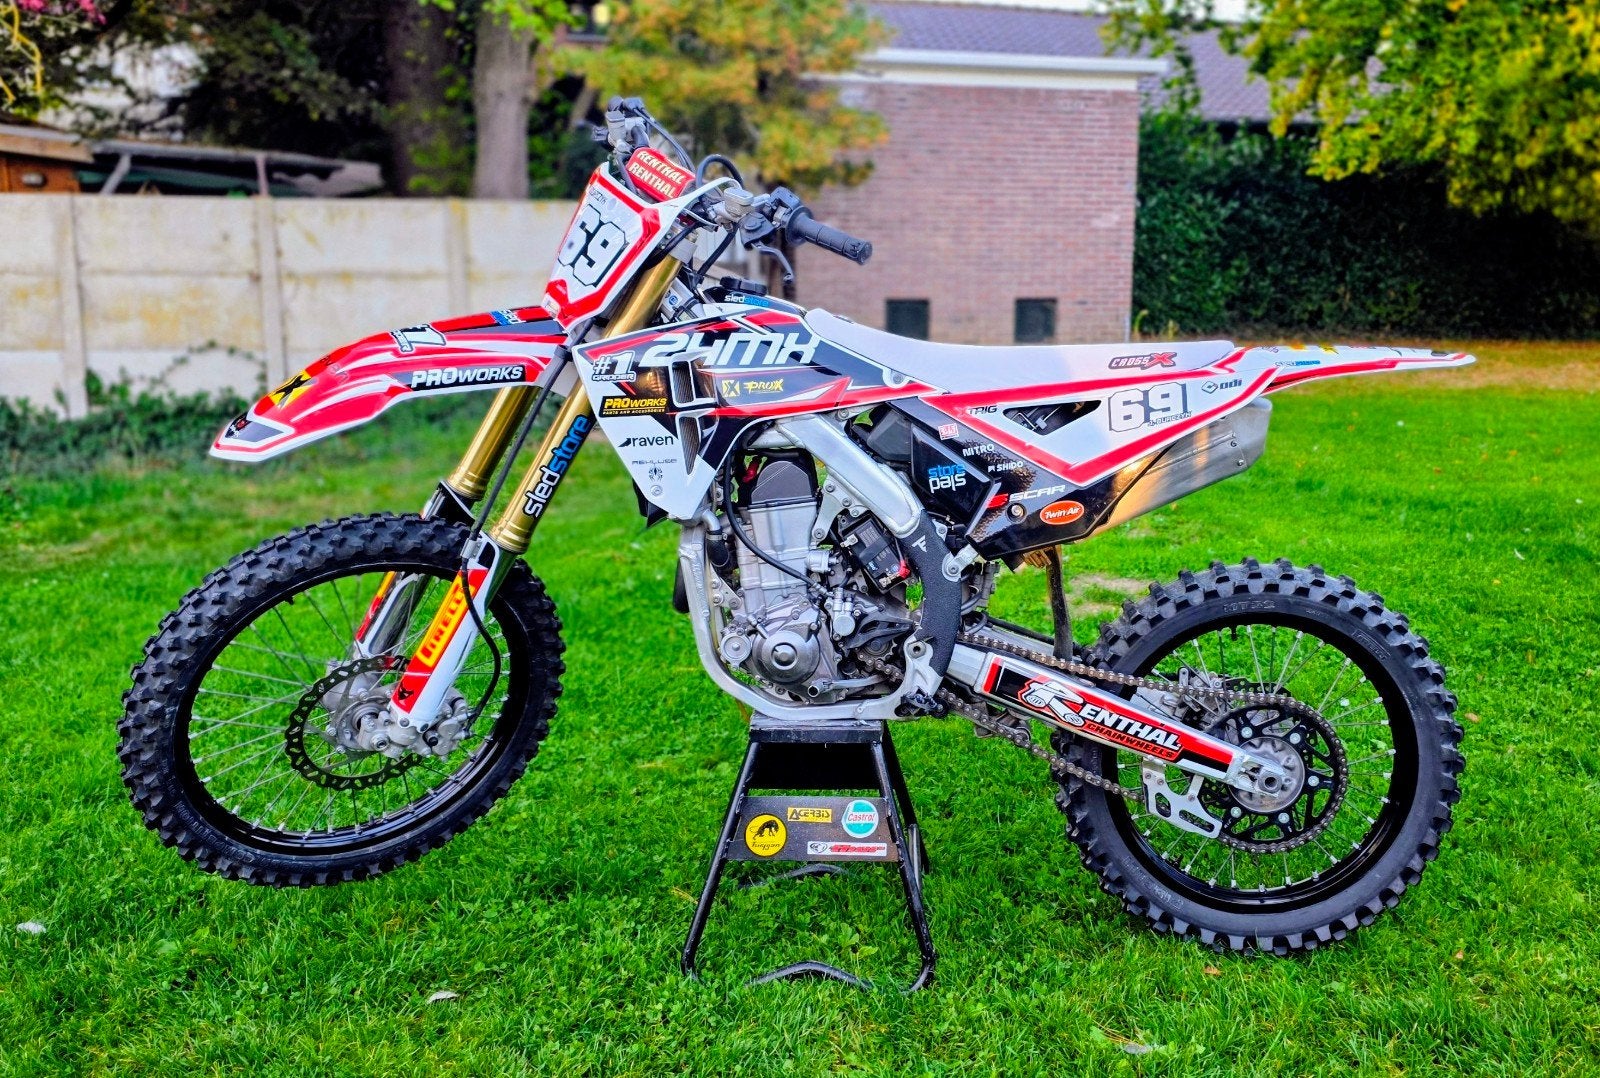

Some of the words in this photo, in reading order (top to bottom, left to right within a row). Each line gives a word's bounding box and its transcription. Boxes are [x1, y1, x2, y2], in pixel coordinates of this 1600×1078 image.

[637, 152, 686, 183] RENTHAL
[628, 162, 678, 198] RENTHAL
[724, 294, 769, 307] sledstore
[638, 332, 818, 367] 24MX
[593, 350, 635, 374] #1
[1219, 379, 1243, 391] odi
[1108, 382, 1189, 433] 69
[631, 435, 674, 447] raven
[962, 443, 995, 457] NITRO
[524, 415, 588, 518] sledstore
[928, 463, 966, 478] store
[996, 460, 1024, 472] SHIDO
[1009, 484, 1066, 502] SCAR
[1045, 510, 1066, 519] Twin
[1066, 506, 1081, 515] Air
[1087, 722, 1176, 759] CHAINWHEELS
[847, 812, 876, 822] Castrol
